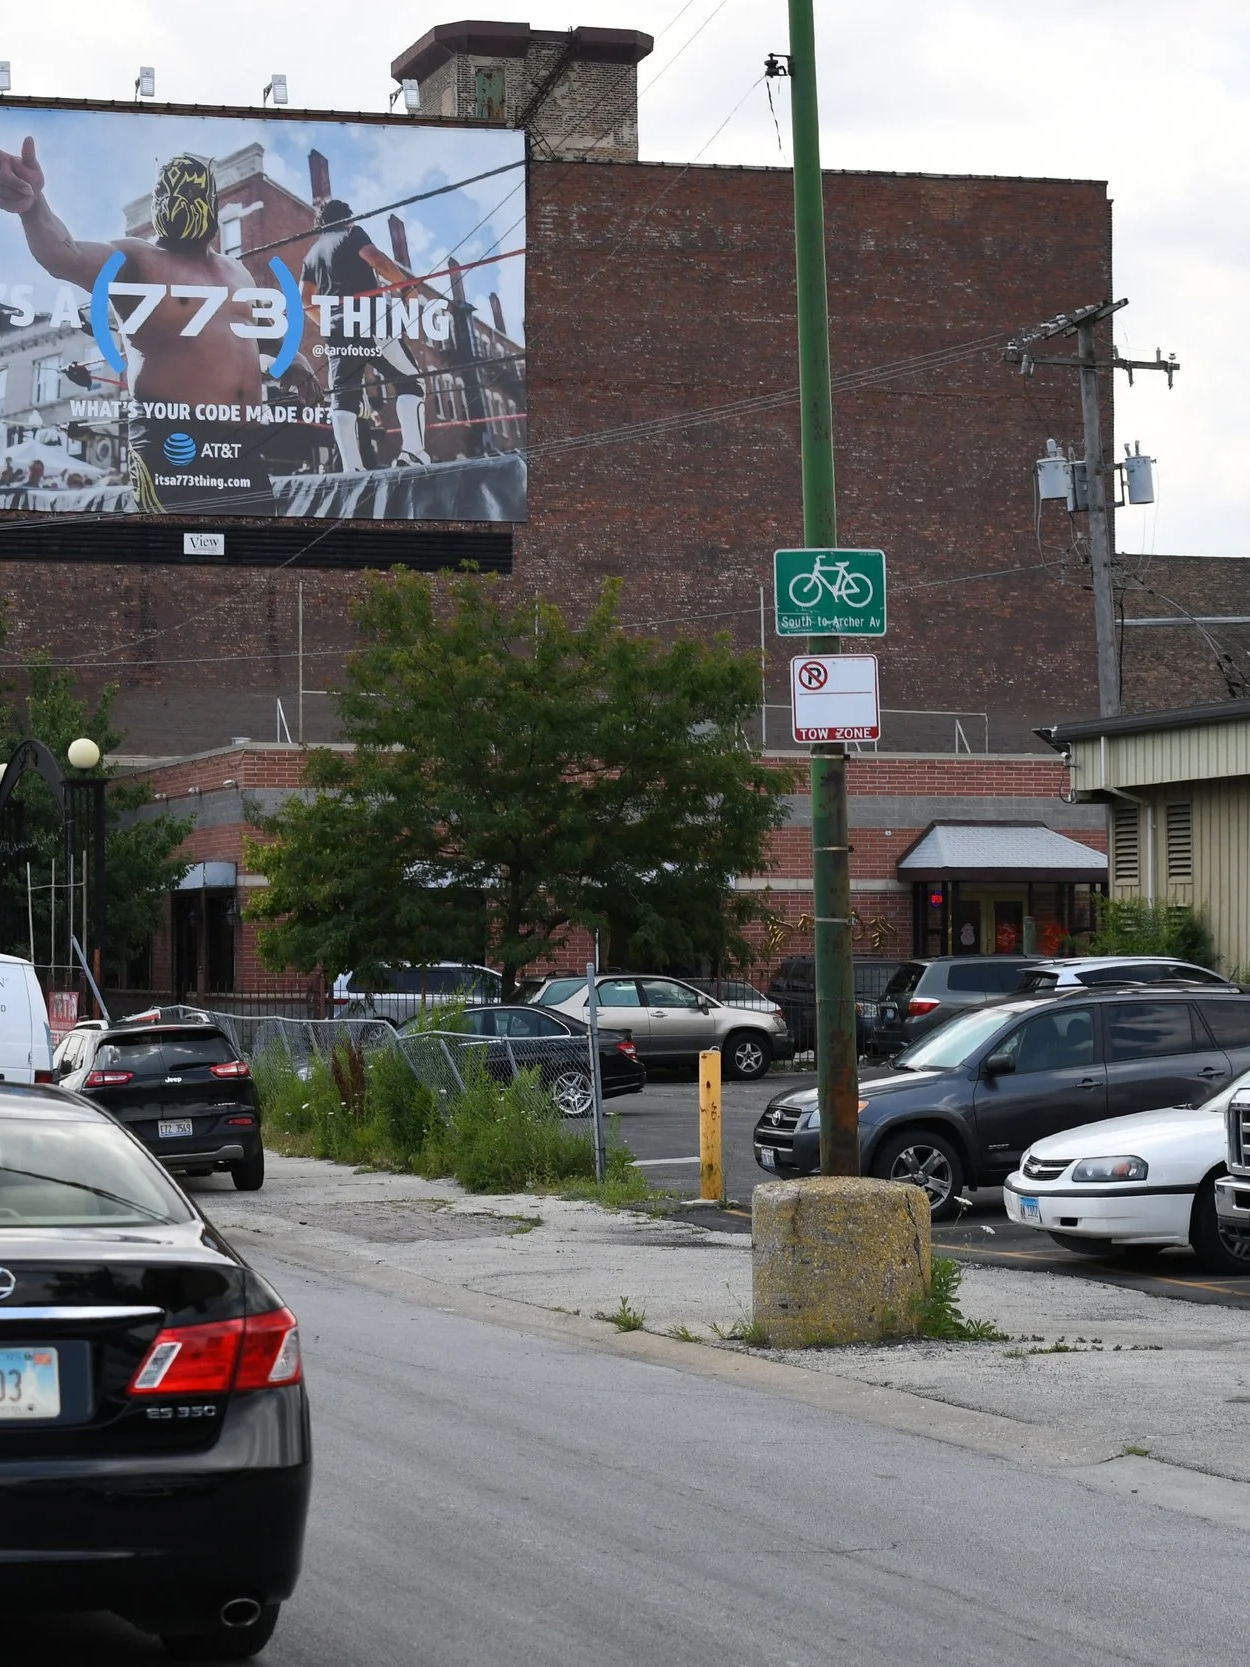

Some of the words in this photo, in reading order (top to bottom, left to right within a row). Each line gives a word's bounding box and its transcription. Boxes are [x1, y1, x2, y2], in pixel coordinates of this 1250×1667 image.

[50, 286, 82, 328] A
[311, 295, 450, 341] THING
[312, 344, 382, 358] @carofotos9
[70, 400, 138, 418] WHAT'S
[143, 402, 191, 420] YOUR
[195, 404, 241, 421] CODE
[246, 405, 297, 423] MADE
[302, 407, 333, 425] OF?
[201, 443, 242, 459] AT&T
[154, 474, 250, 489] itsa773thing.com
[190, 534, 219, 549] View
[781, 616, 812, 628] South
[817, 616, 827, 627] to
[833, 616, 864, 627] Archer
[869, 616, 881, 628] Av
[800, 729, 828, 740] TOW
[835, 728, 872, 739] ZONE
[146, 1407, 173, 1419] ES
[177, 1405, 216, 1417] 350
